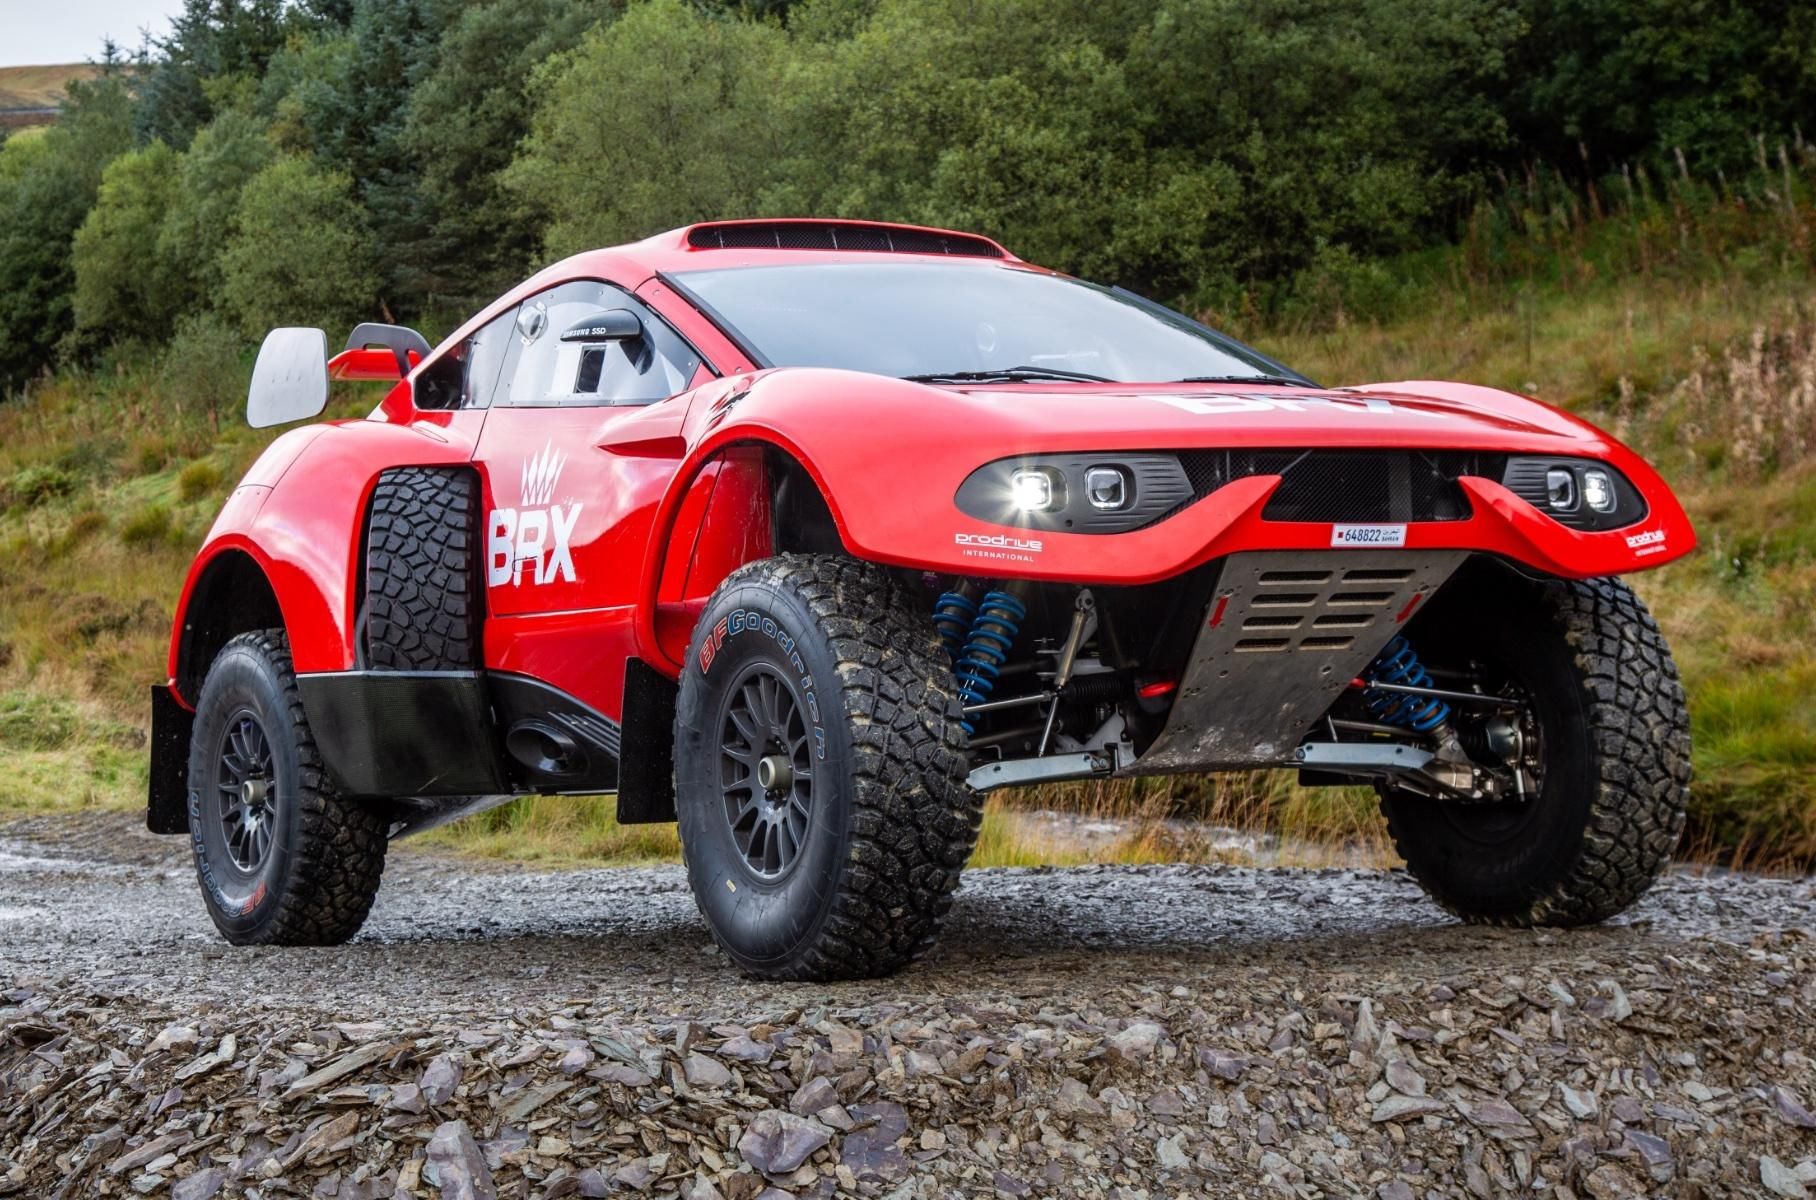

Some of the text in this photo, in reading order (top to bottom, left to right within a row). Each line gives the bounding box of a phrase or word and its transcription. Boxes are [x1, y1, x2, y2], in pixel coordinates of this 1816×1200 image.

[591, 327, 606, 335] SSD
[1345, 528, 1381, 542] 648822
[488, 503, 583, 588] BRX
[955, 533, 1043, 552] prodrive
[963, 549, 1034, 562] INTERNATIONAL
